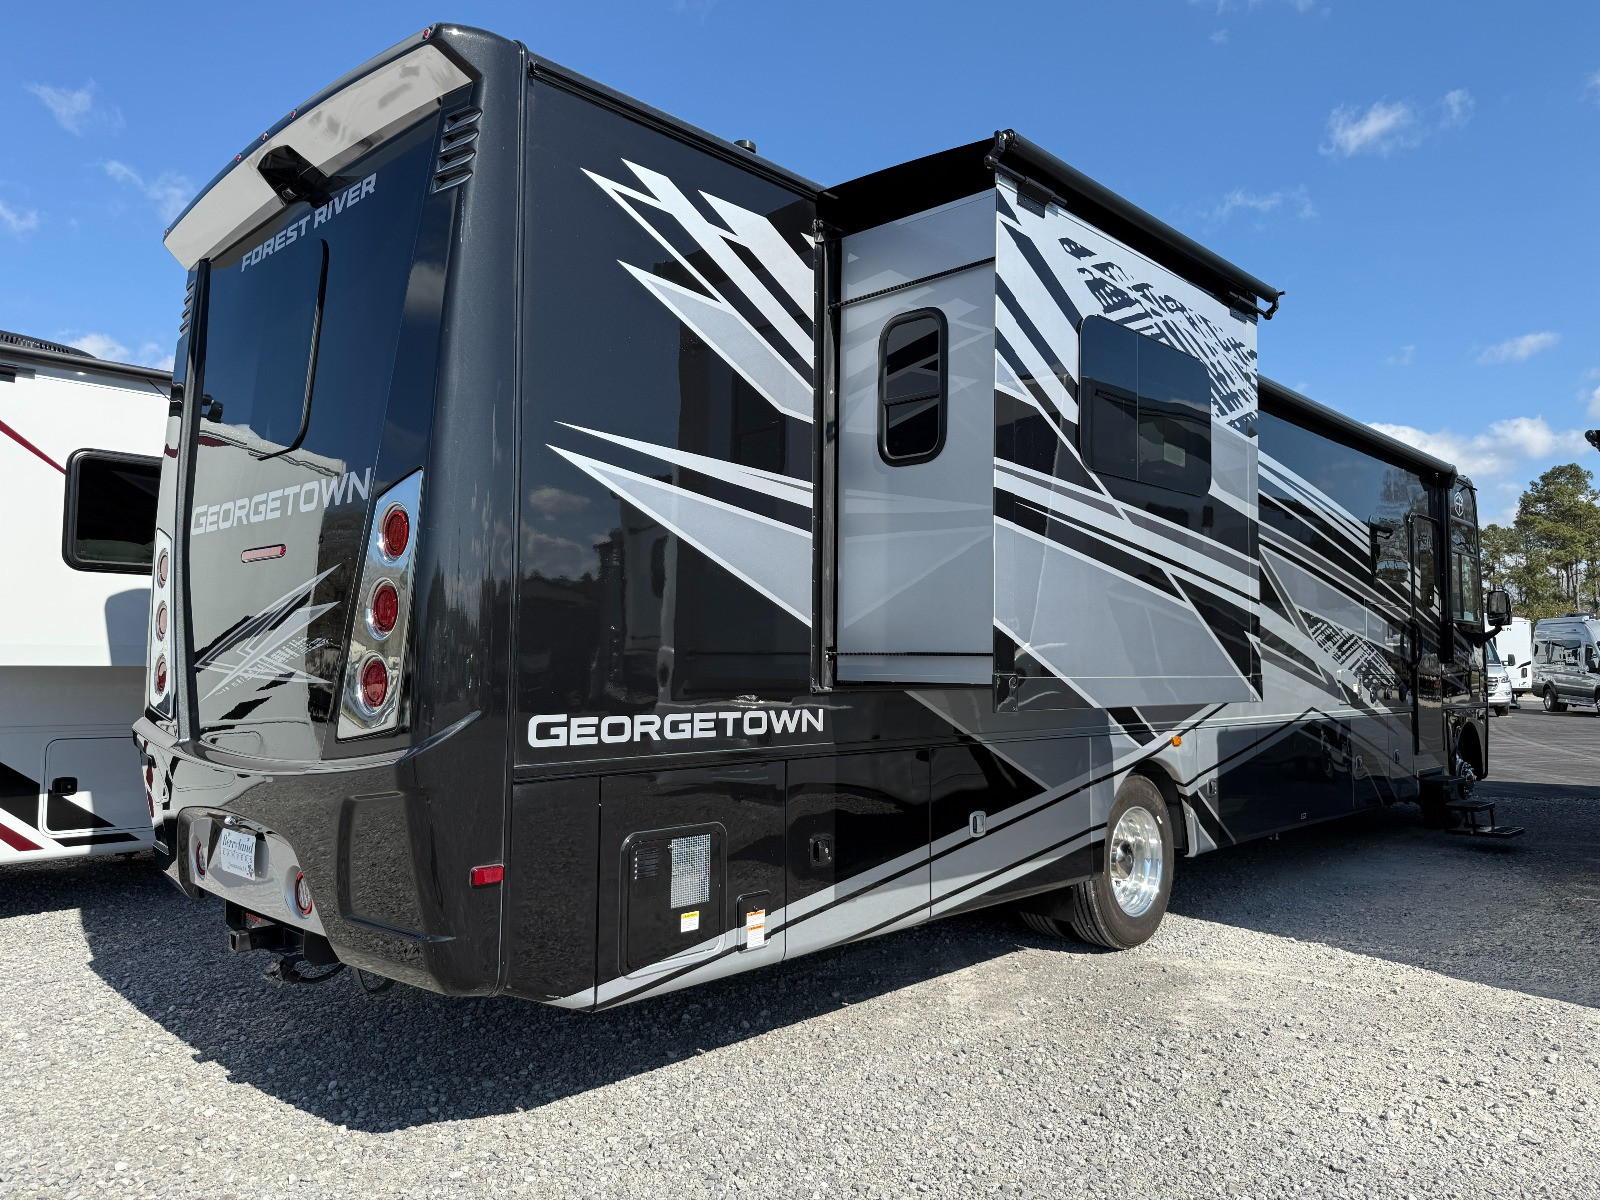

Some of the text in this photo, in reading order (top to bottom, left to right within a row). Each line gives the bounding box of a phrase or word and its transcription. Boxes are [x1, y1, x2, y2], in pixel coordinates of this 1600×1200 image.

[241, 173, 377, 272] FOREST RIVER
[190, 467, 371, 535] GEORGETOWN
[528, 708, 824, 748] GEORGETOWN
